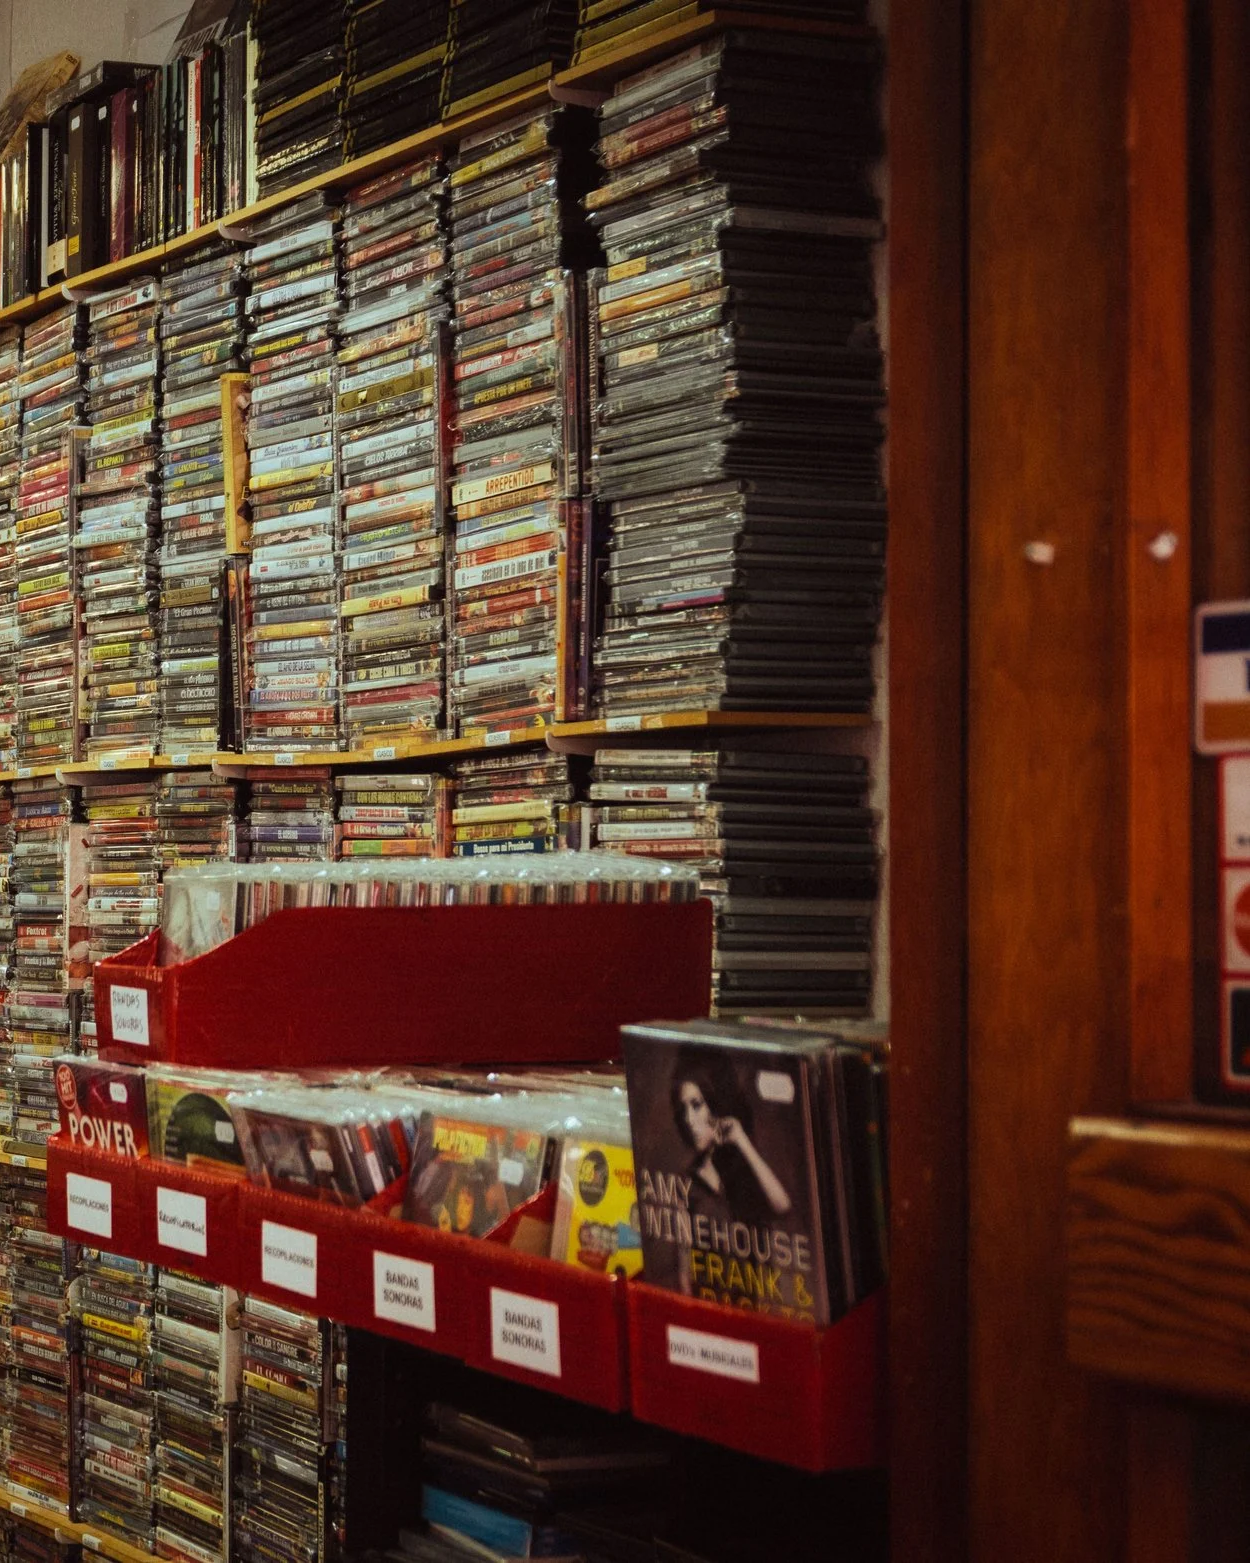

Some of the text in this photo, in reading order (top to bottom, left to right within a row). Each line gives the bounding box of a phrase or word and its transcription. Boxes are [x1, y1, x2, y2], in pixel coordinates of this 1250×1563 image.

[489, 133, 517, 149] ANA
[391, 263, 413, 280] AMOR
[588, 307, 598, 423] ERNEST HEMINGWAY
[485, 469, 535, 493] ARREPENTIDO
[26, 926, 47, 937] Foxtrot
[112, 990, 141, 1009] BANDAS
[114, 1012, 144, 1034] SONORAS
[67, 1112, 139, 1159] POWER
[641, 1167, 692, 1208] AMY
[69, 1194, 110, 1214] RECOPILACIONES
[643, 1204, 812, 1272] WINEHOUSE
[264, 1245, 315, 1270] RECOPILACIONES
[386, 1270, 419, 1291] BANDAS
[689, 1249, 814, 1306] FRANK &
[383, 1288, 424, 1312] SONORAS
[505, 1311, 543, 1333] BANDAS
[501, 1331, 547, 1354] SONORAS
